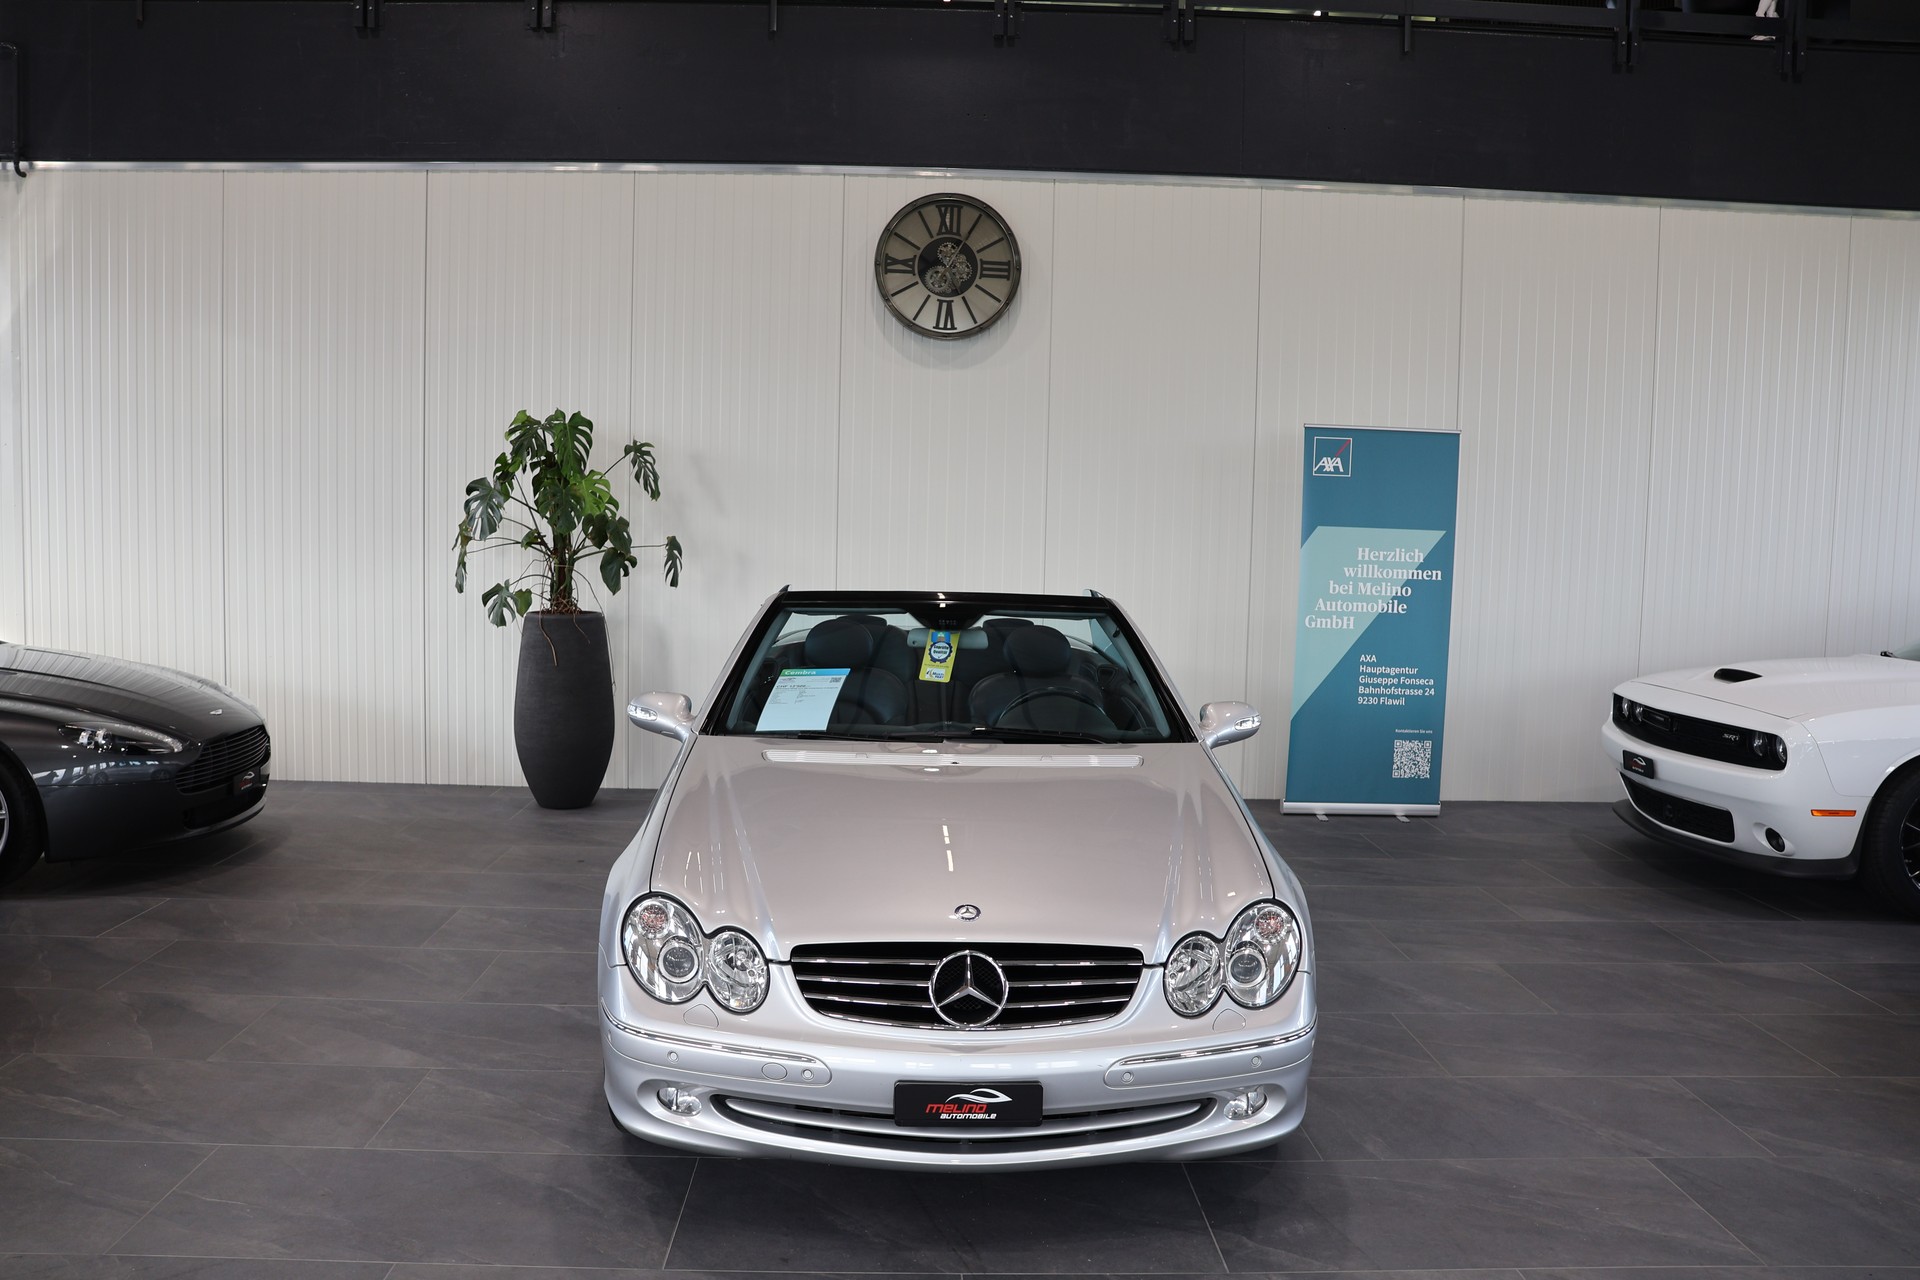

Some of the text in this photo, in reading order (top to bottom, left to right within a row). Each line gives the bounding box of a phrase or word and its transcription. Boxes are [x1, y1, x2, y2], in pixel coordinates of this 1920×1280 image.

[935, 204, 964, 237] XII
[978, 258, 1011, 281] III
[1314, 456, 1344, 472] AXA
[1357, 547, 1424, 563] Herzlich
[1343, 564, 1442, 581] willkommen
[1329, 580, 1412, 597] bei Melino
[1315, 598, 1407, 614] Automobile
[1304, 615, 1355, 630] GmbH
[1359, 654, 1377, 663] AXA
[1359, 665, 1418, 675] Hauptagentur
[1359, 675, 1434, 686] Giuseppe Fonseca
[1358, 686, 1435, 696] Bahnhofstrasse 24
[1357, 696, 1405, 706] 9230 Flawil
